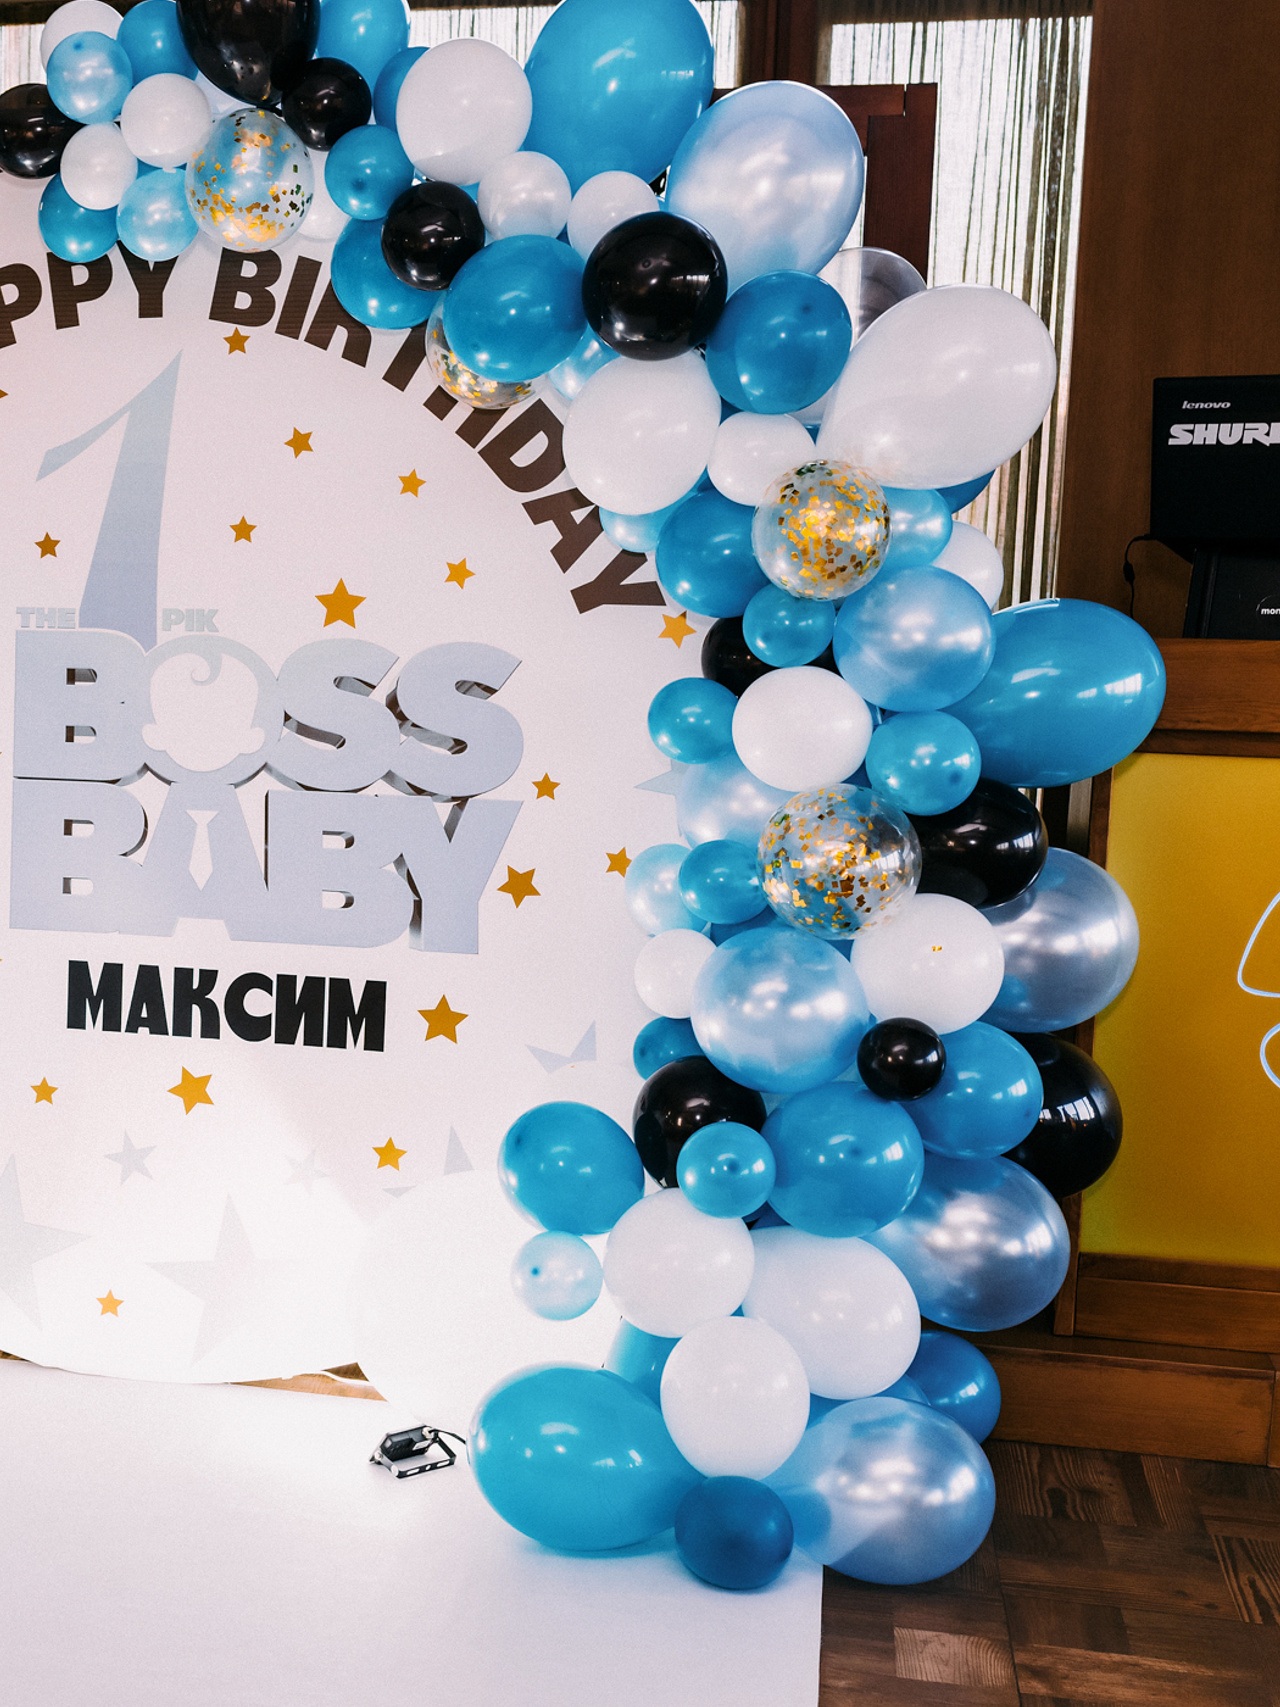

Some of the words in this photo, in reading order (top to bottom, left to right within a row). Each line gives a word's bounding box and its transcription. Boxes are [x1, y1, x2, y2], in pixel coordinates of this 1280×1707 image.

[1182, 400, 1231, 410] lenovo
[36, 349, 183, 654] 1
[15, 606, 77, 630] THE
[13, 629, 525, 803] BOSS
[9, 780, 525, 955] BABY
[66, 959, 388, 1053] МАКСИМ
